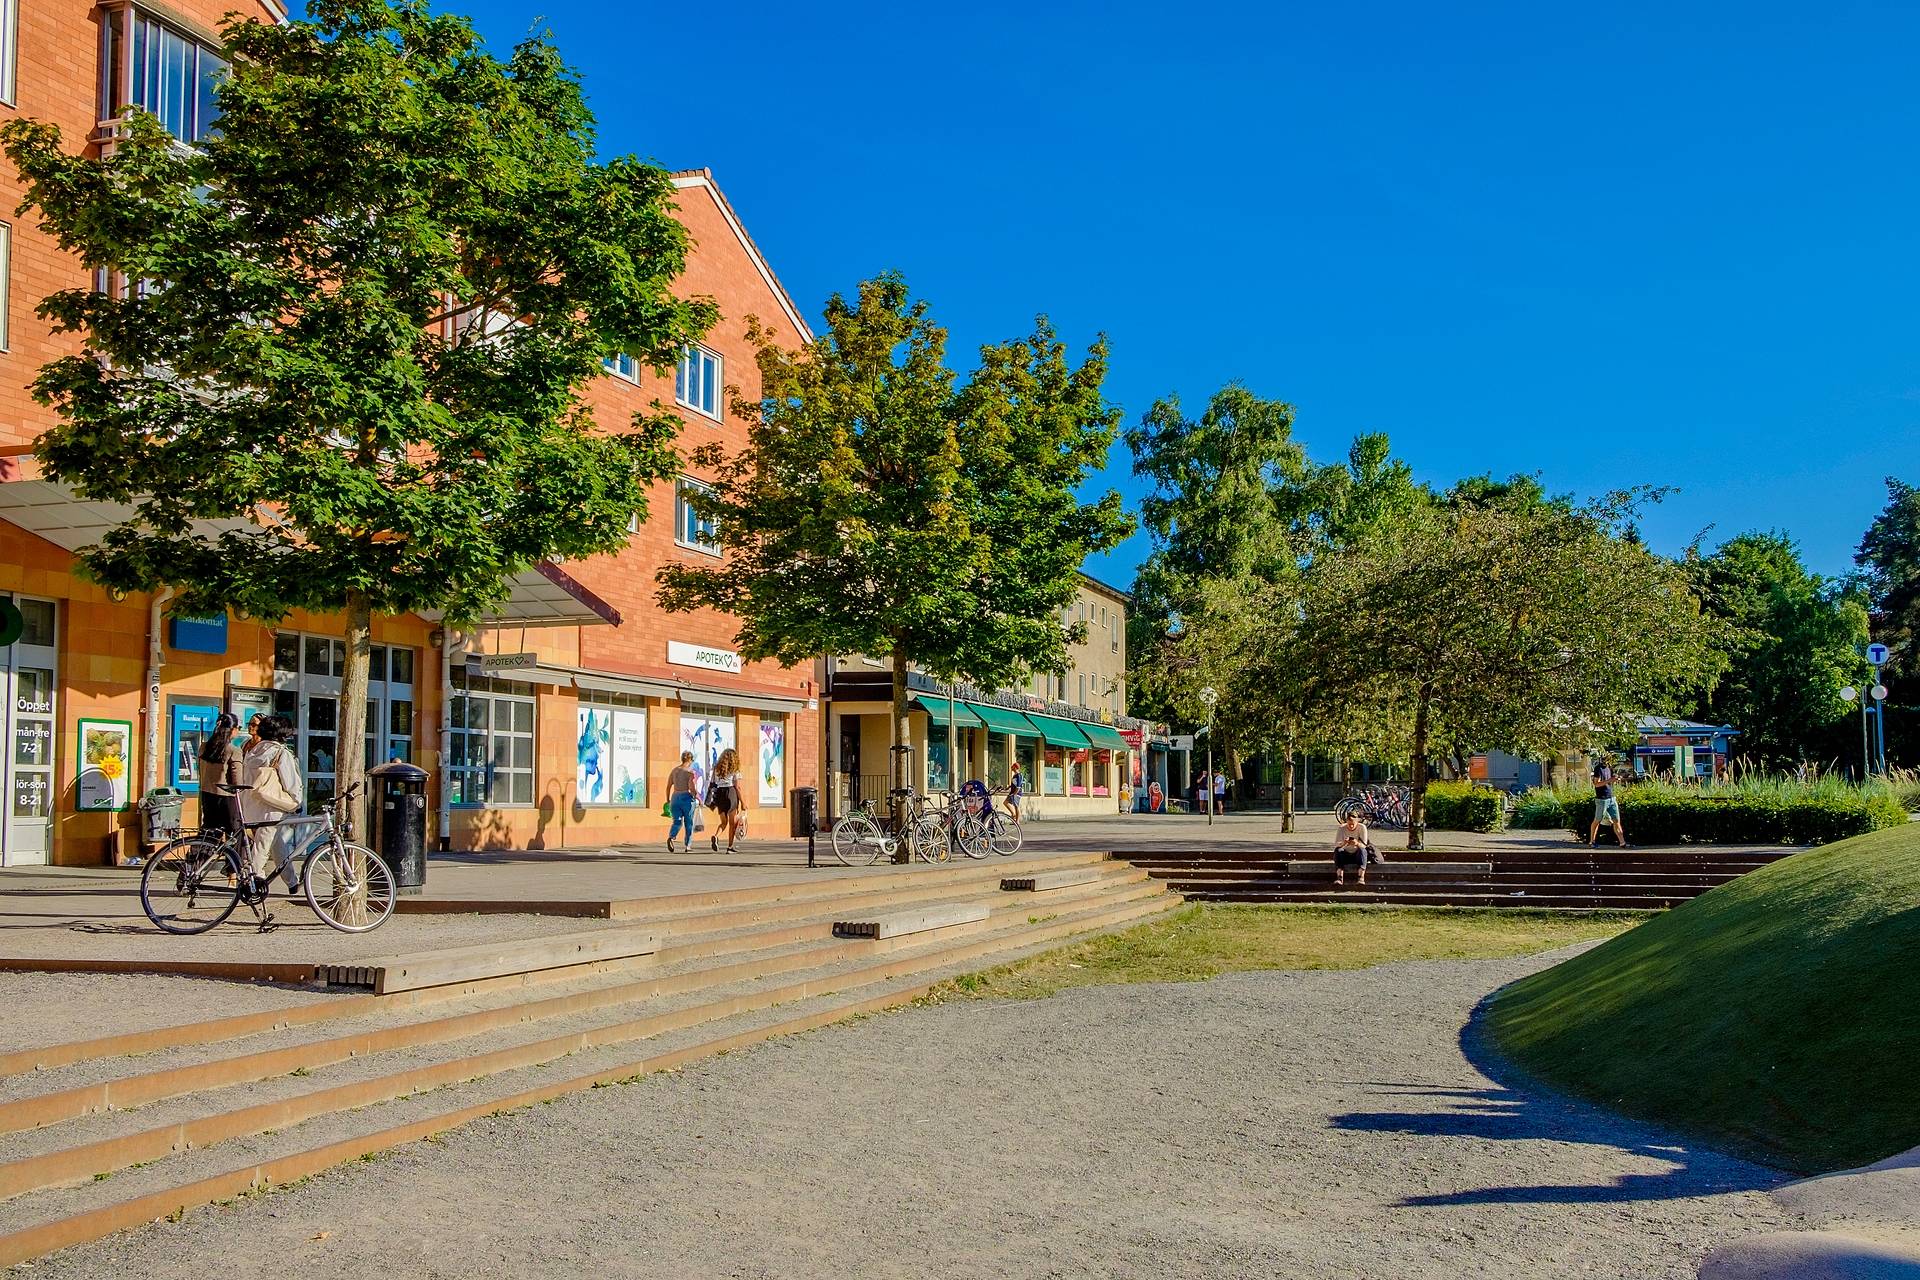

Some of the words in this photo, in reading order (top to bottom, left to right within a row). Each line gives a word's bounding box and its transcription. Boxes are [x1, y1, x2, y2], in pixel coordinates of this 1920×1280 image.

[695, 651, 723, 665] APOTEK
[1871, 648, 1886, 661] T
[485, 657, 514, 667] APOTEK
[17, 696, 50, 712] Öppet
[16, 726, 50, 738] mån-fre
[21, 742, 42, 753] 7-21
[20, 794, 42, 805] 8-21
